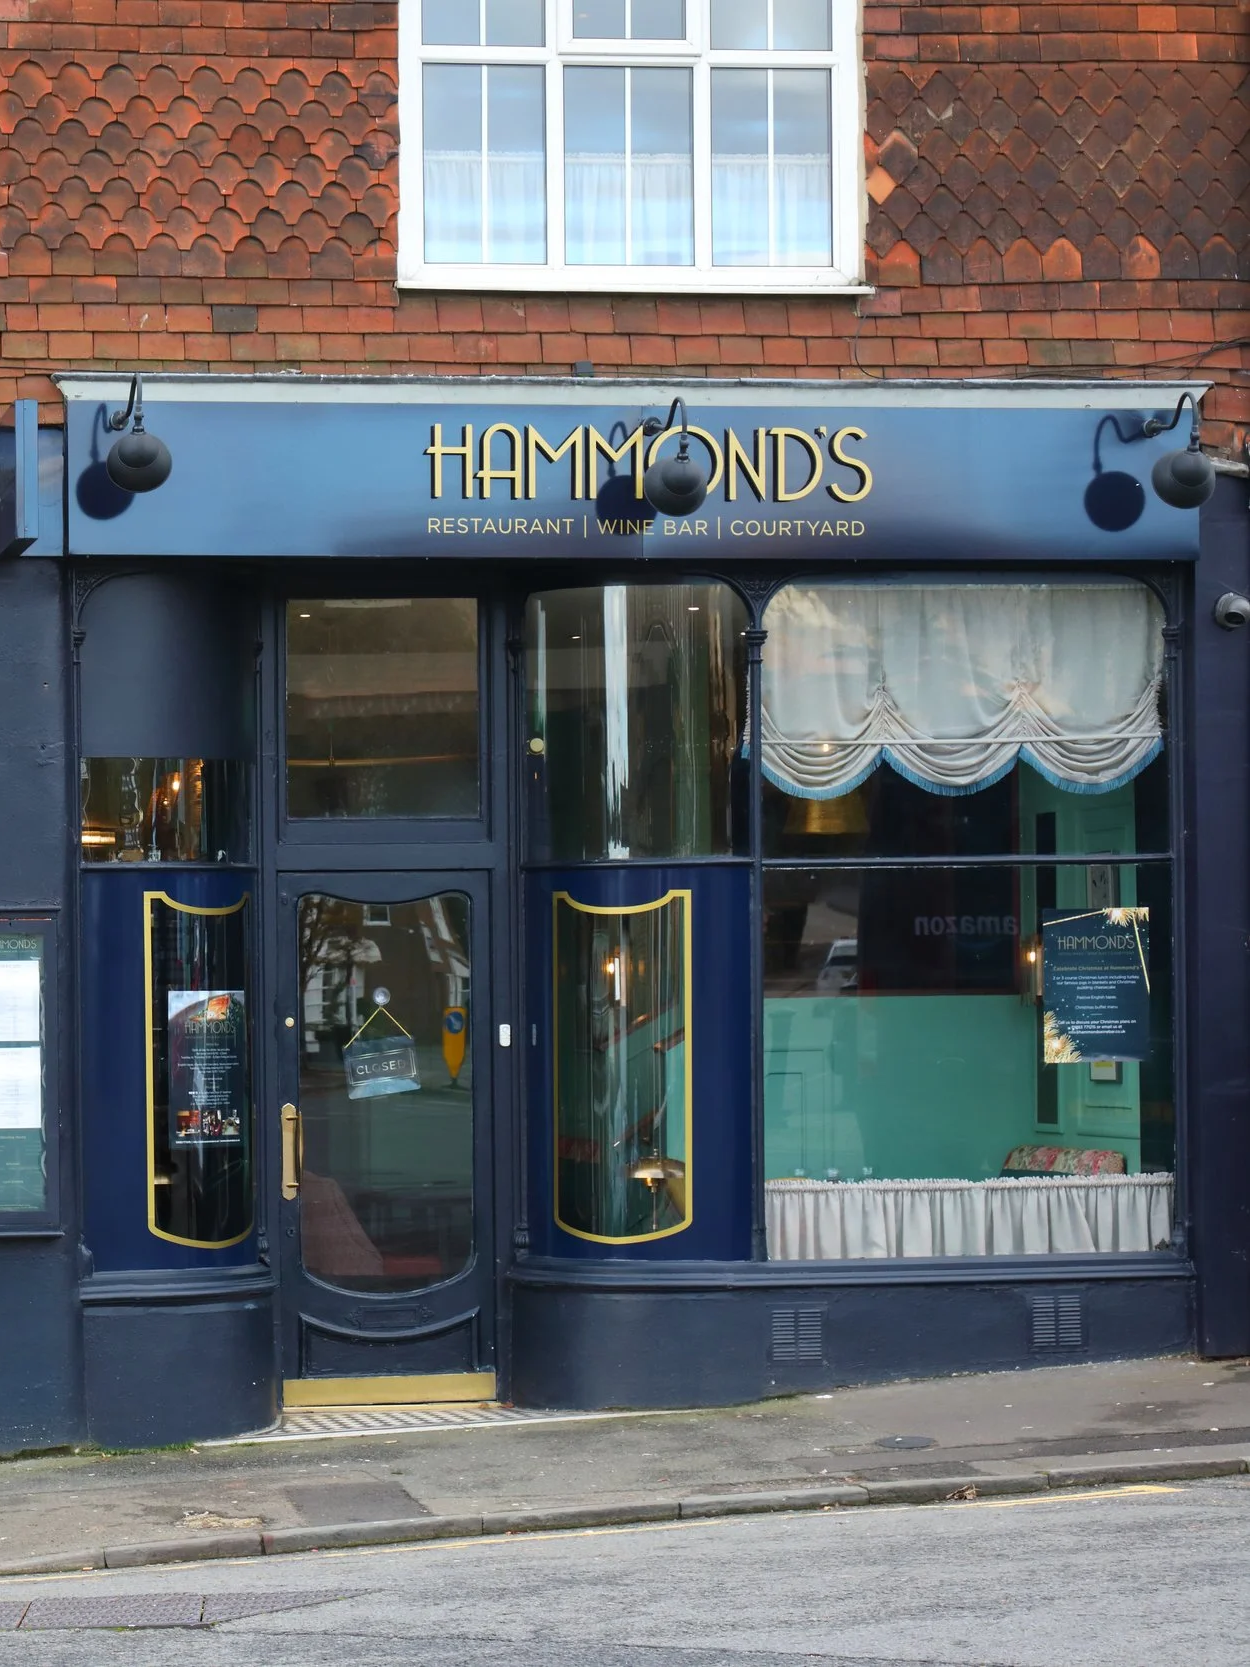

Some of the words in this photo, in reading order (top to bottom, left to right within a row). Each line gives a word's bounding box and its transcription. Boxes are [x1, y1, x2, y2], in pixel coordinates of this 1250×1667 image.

[426, 424, 874, 503] HAMMOND'S
[426, 517, 576, 535] RESTAURANT
[597, 519, 655, 535] WINE
[663, 519, 708, 536] BAR
[730, 520, 866, 537] COURTYARD
[356, 1059, 407, 1075] CLOSED
